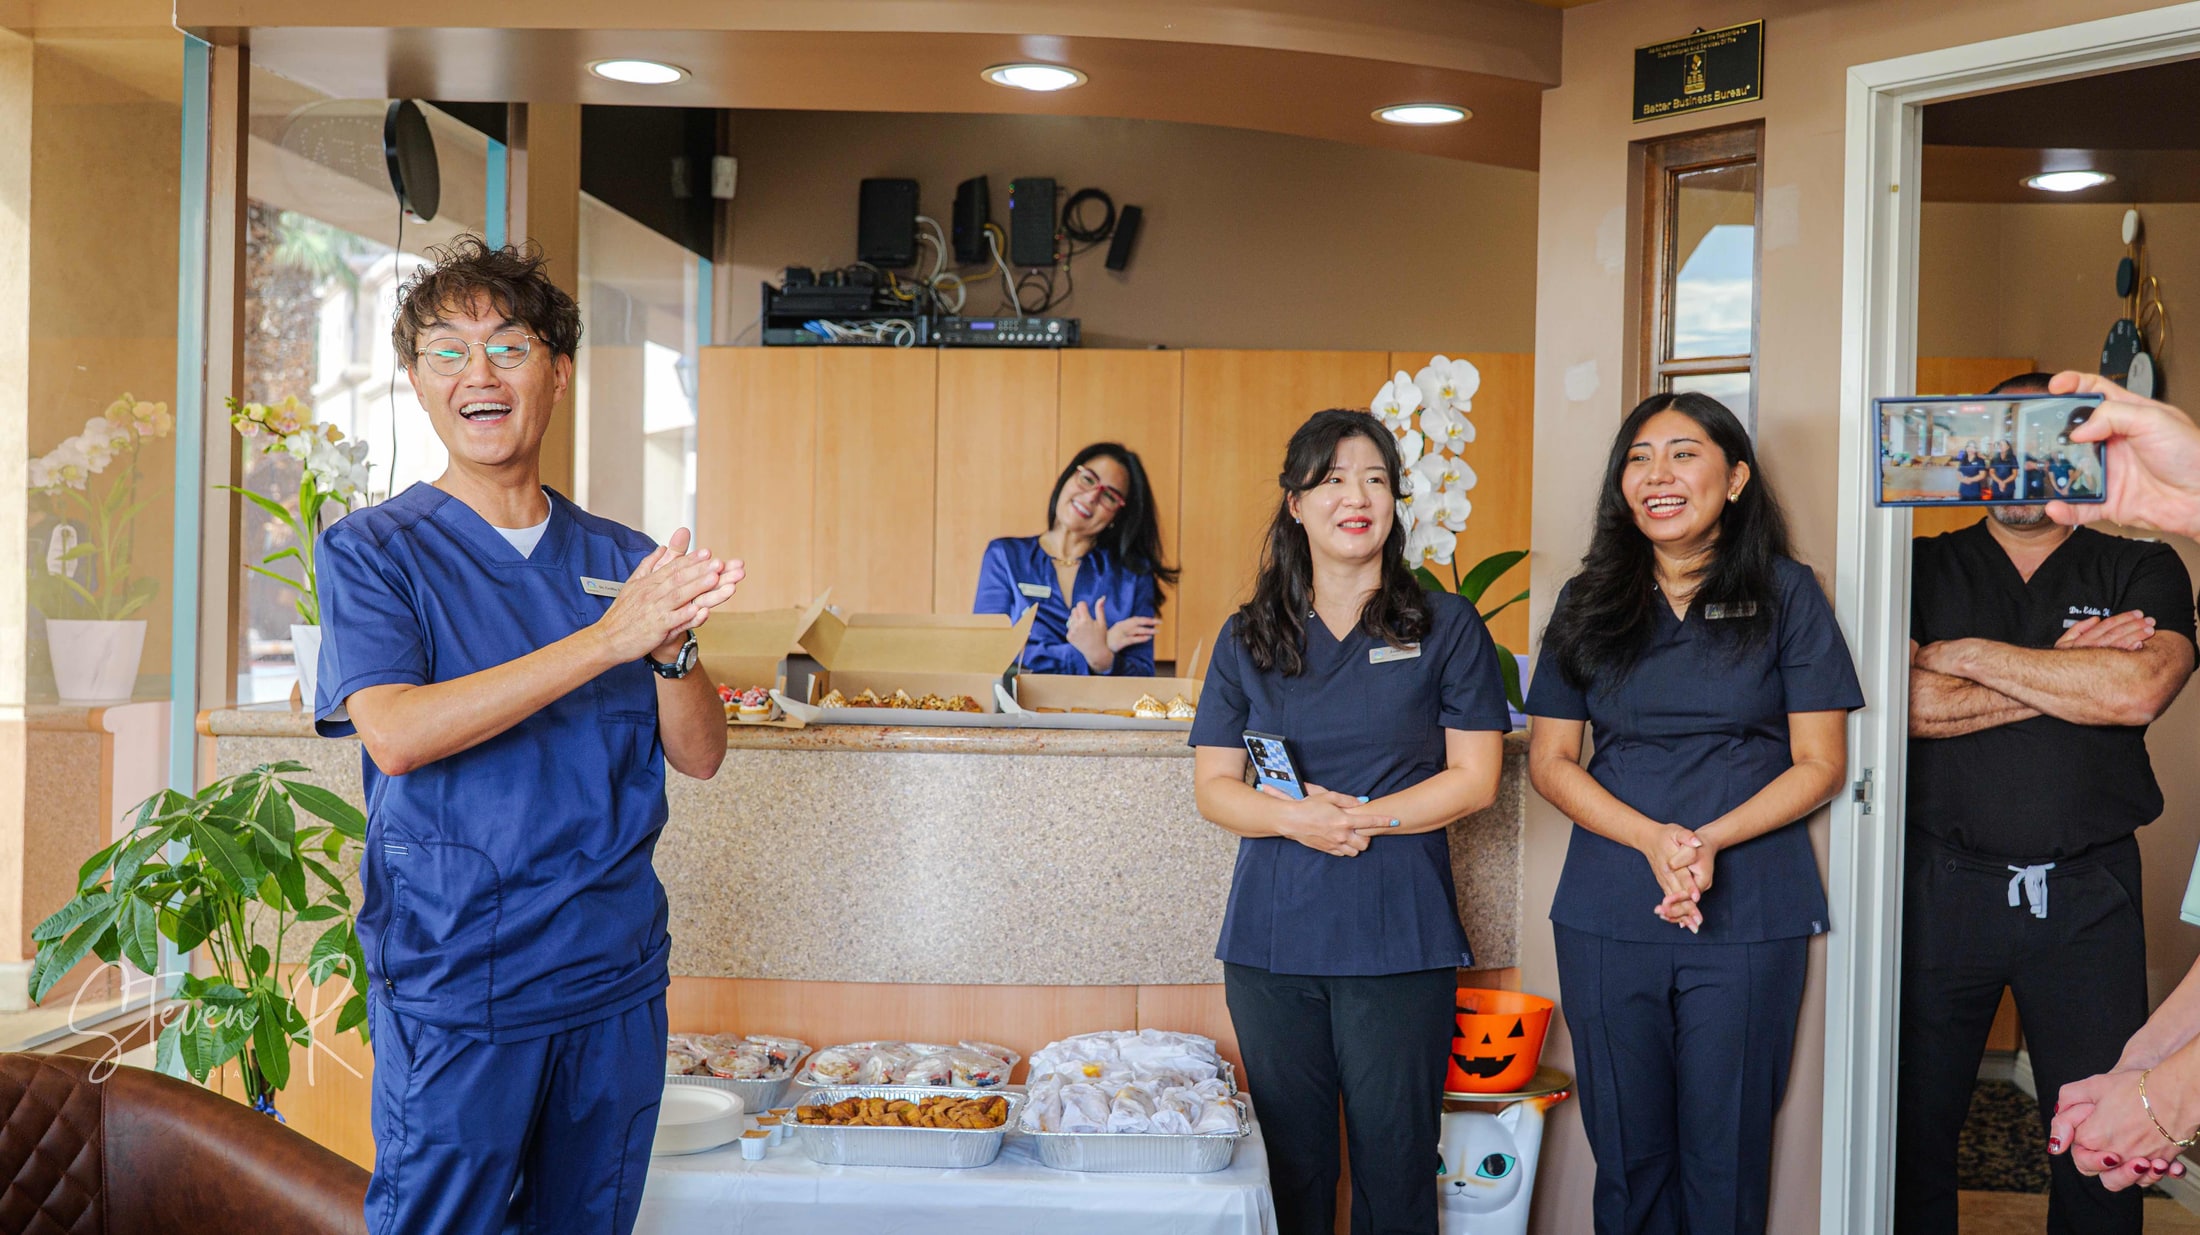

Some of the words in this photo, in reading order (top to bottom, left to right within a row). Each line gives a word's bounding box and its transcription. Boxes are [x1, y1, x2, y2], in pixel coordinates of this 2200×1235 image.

[1643, 101, 1672, 115] Better
[1673, 93, 1713, 109] Business
[2083, 606, 2101, 615] Eddie
